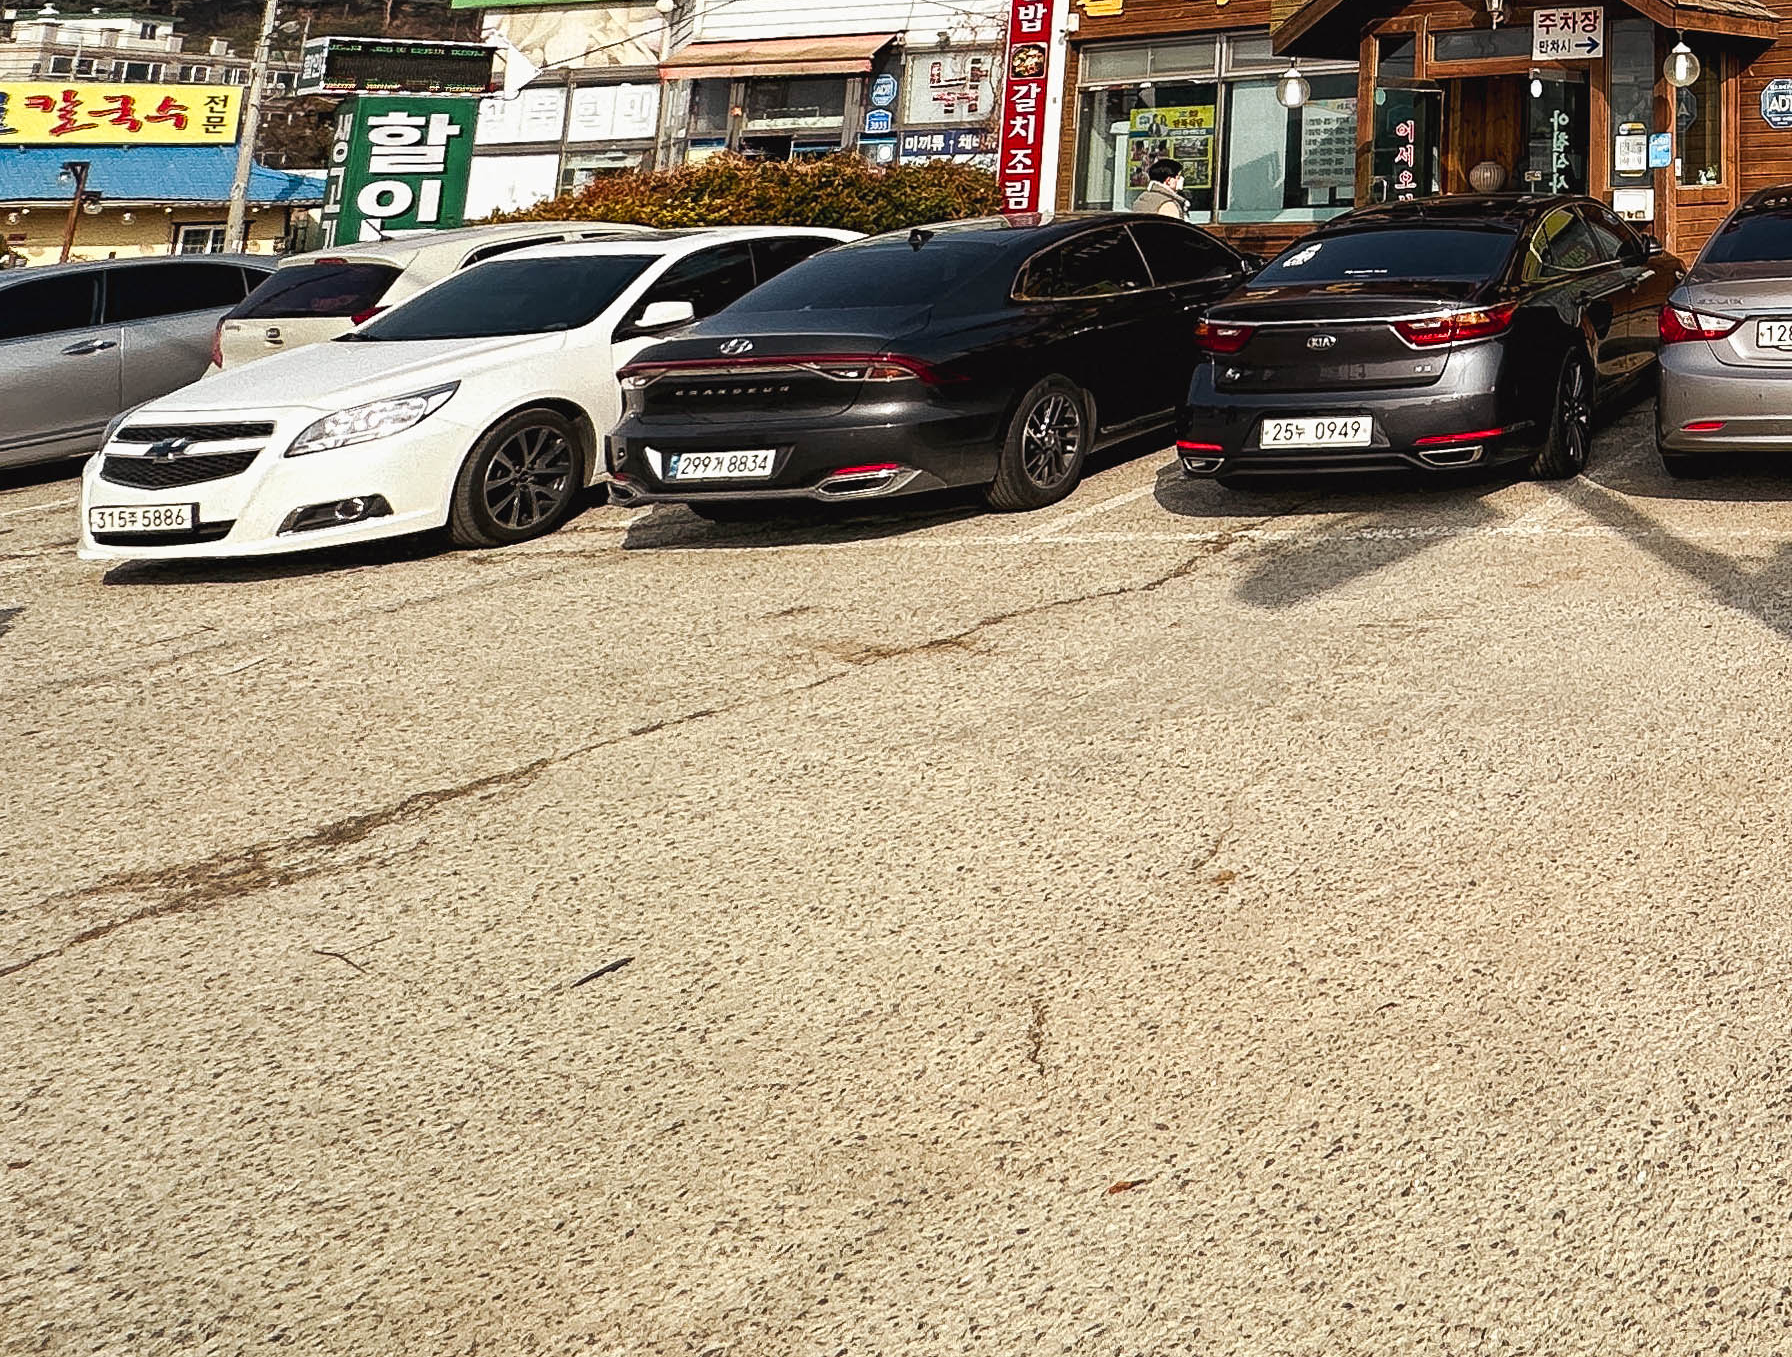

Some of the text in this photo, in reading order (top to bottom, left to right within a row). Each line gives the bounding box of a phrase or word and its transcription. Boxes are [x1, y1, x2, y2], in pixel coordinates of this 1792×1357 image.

[1538, 10, 1600, 35] 주차장
[1538, 39, 1571, 54] 만차시
[24, 89, 189, 136] 칼국수
[201, 95, 230, 134] 전문
[905, 134, 945, 151] 미끼류
[1003, 82, 1042, 211] 갈치조림
[358, 112, 461, 243] 할인
[1309, 336, 1333, 348] KIA
[1315, 420, 1361, 441] 0949
[727, 454, 769, 473] 8834
[142, 508, 185, 528] 5886
